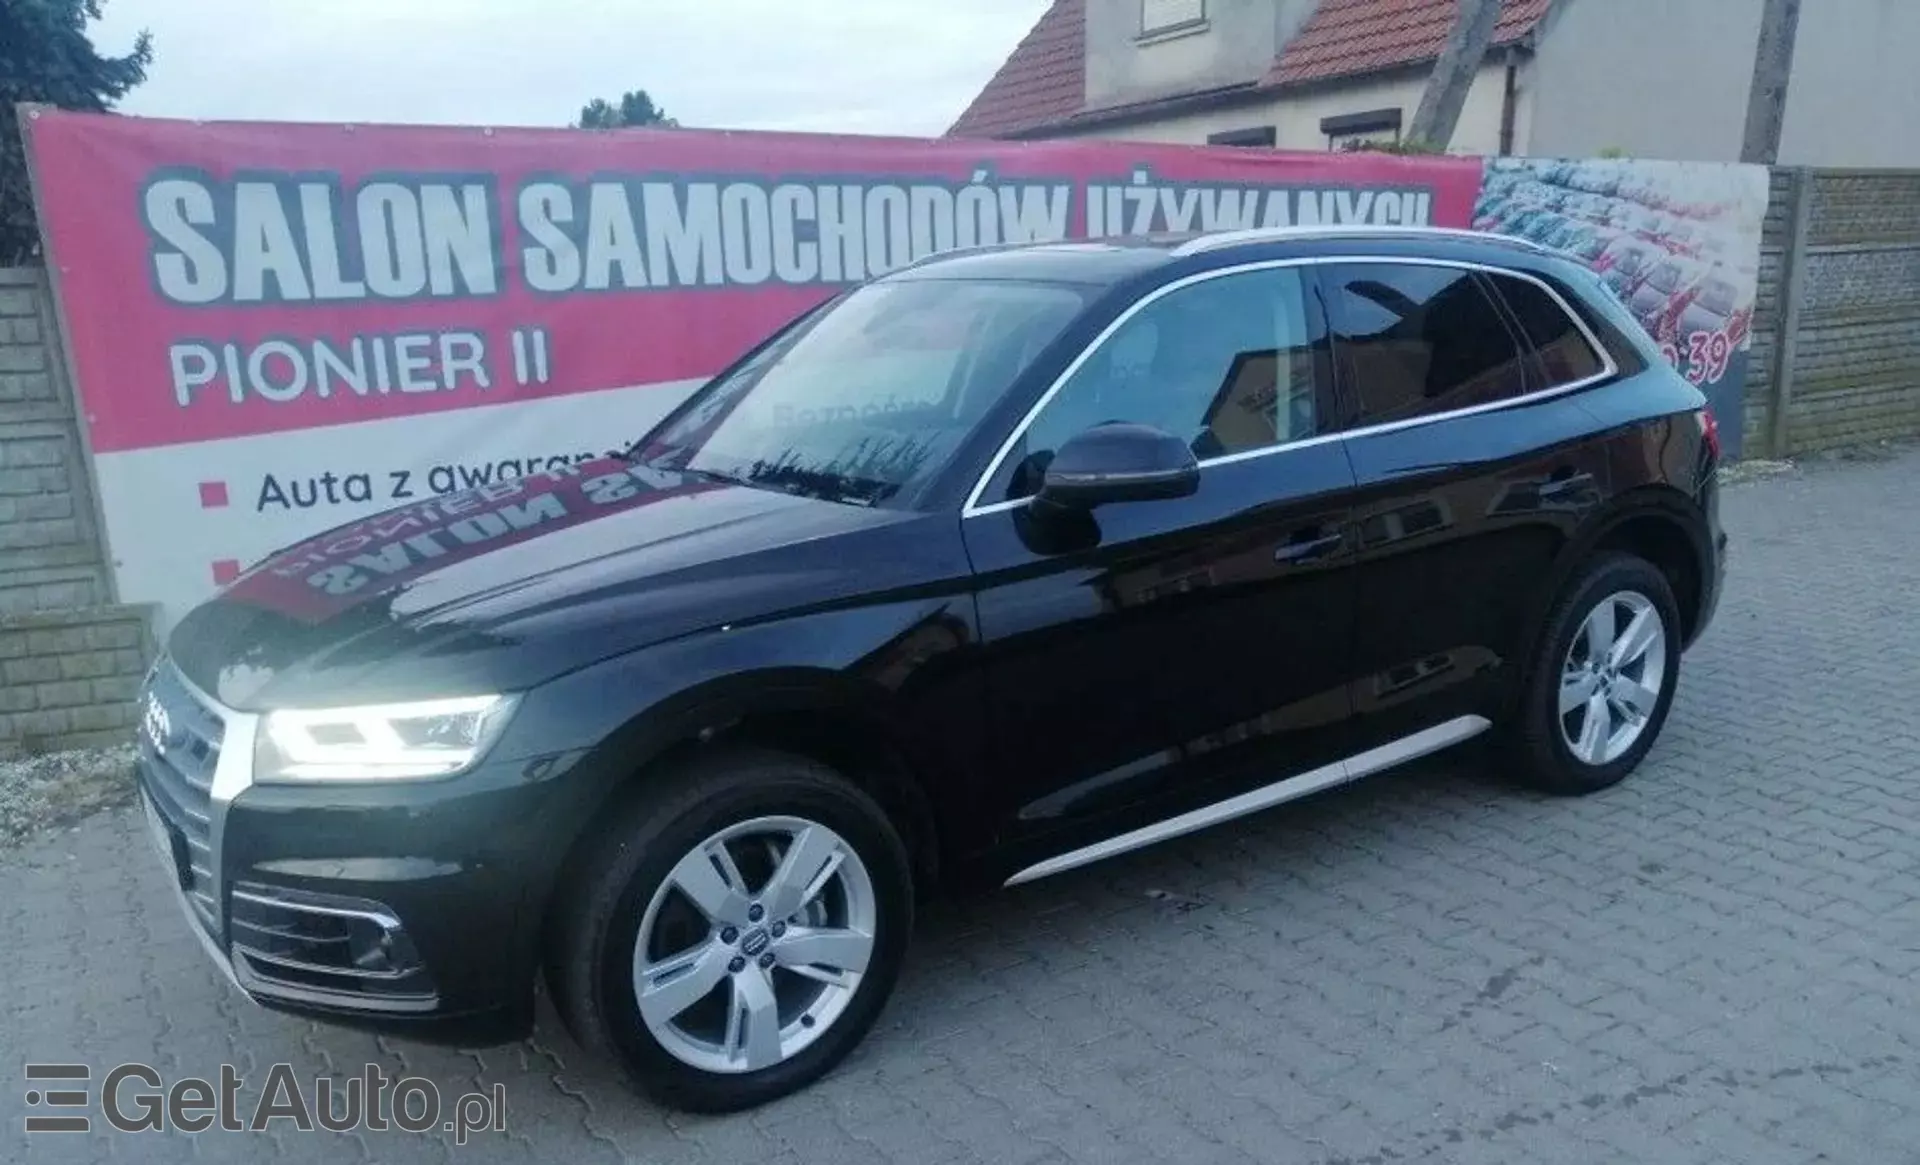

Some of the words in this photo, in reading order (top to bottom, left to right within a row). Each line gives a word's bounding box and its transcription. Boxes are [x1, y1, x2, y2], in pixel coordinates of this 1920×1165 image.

[145, 180, 498, 303] SALON
[518, 169, 1071, 293] SAMOCHODÓW
[170, 333, 490, 406] PIONIER
[512, 329, 549, 384] II
[257, 473, 373, 512] Auta
[389, 471, 413, 499] z
